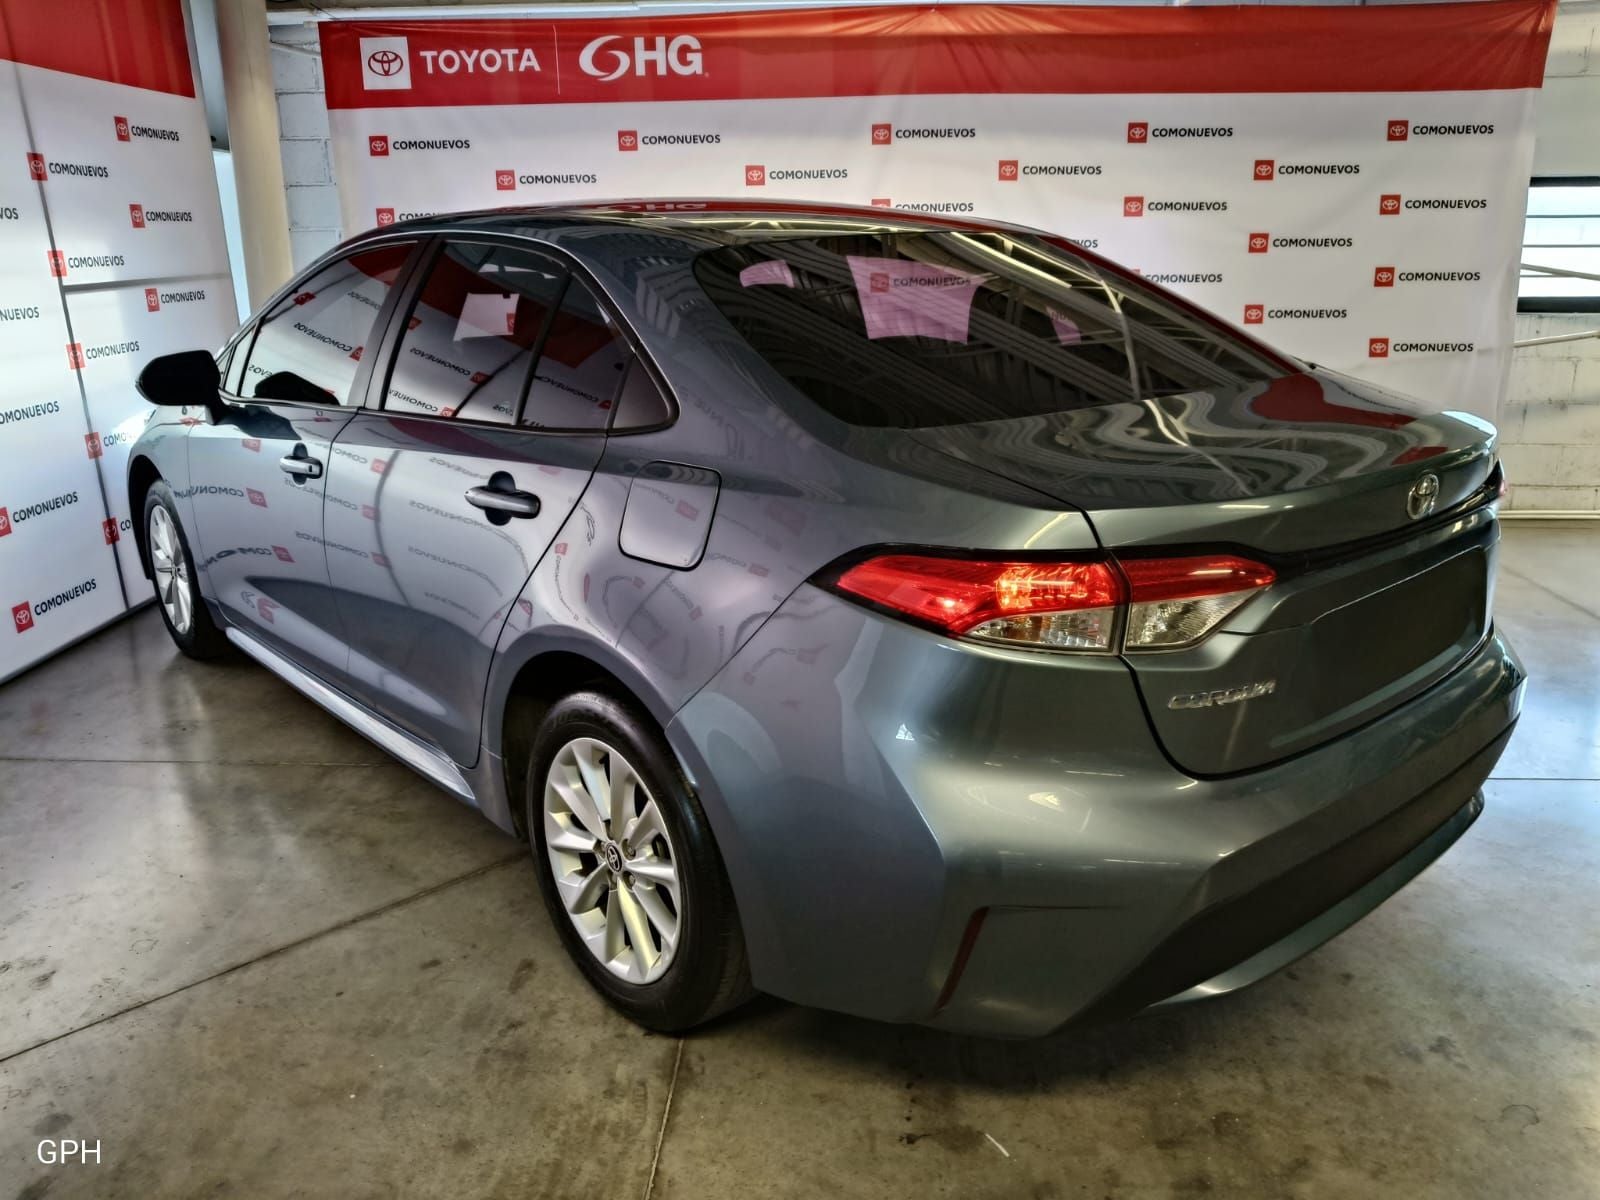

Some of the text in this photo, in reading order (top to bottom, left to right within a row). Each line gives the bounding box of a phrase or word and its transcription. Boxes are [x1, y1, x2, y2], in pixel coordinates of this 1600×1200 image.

[420, 48, 541, 75] TOYOTA
[130, 125, 180, 142] COMONUEVOS
[895, 128, 976, 139] COMONUEVOS
[1152, 127, 1234, 138] COMONUEVOS
[1413, 124, 1494, 136] COMONUEVOS
[392, 139, 471, 151] COMONUEVOS
[641, 134, 721, 145] COMONUEVOS
[48, 162, 109, 178] COMONUEVOS
[769, 168, 848, 180] COMONUEVOS
[1022, 165, 1102, 176] COMONUEVOS
[1278, 164, 1360, 175] COMONUEVOS
[519, 174, 597, 185] COMONUEVOS
[1147, 201, 1228, 212] COMONUEVOS
[1404, 199, 1487, 210] COMONUEVOS
[145, 211, 193, 222] COMONUEVOS
[1272, 237, 1353, 248] COMONUEVOS
[68, 255, 125, 269] COMONUEVOS
[1398, 271, 1481, 282] COMONUEVOS
[160, 290, 206, 304] COMONUEVOS
[0, 306, 40, 321] NUEVOS
[1268, 308, 1348, 320] COMONUEVOS
[85, 340, 141, 360] COMONUEVOS
[1393, 342, 1474, 353] COMONUEVOS
[12, 491, 79, 523] COMONUEVOS
[34, 578, 97, 616] COMONUEVOS
